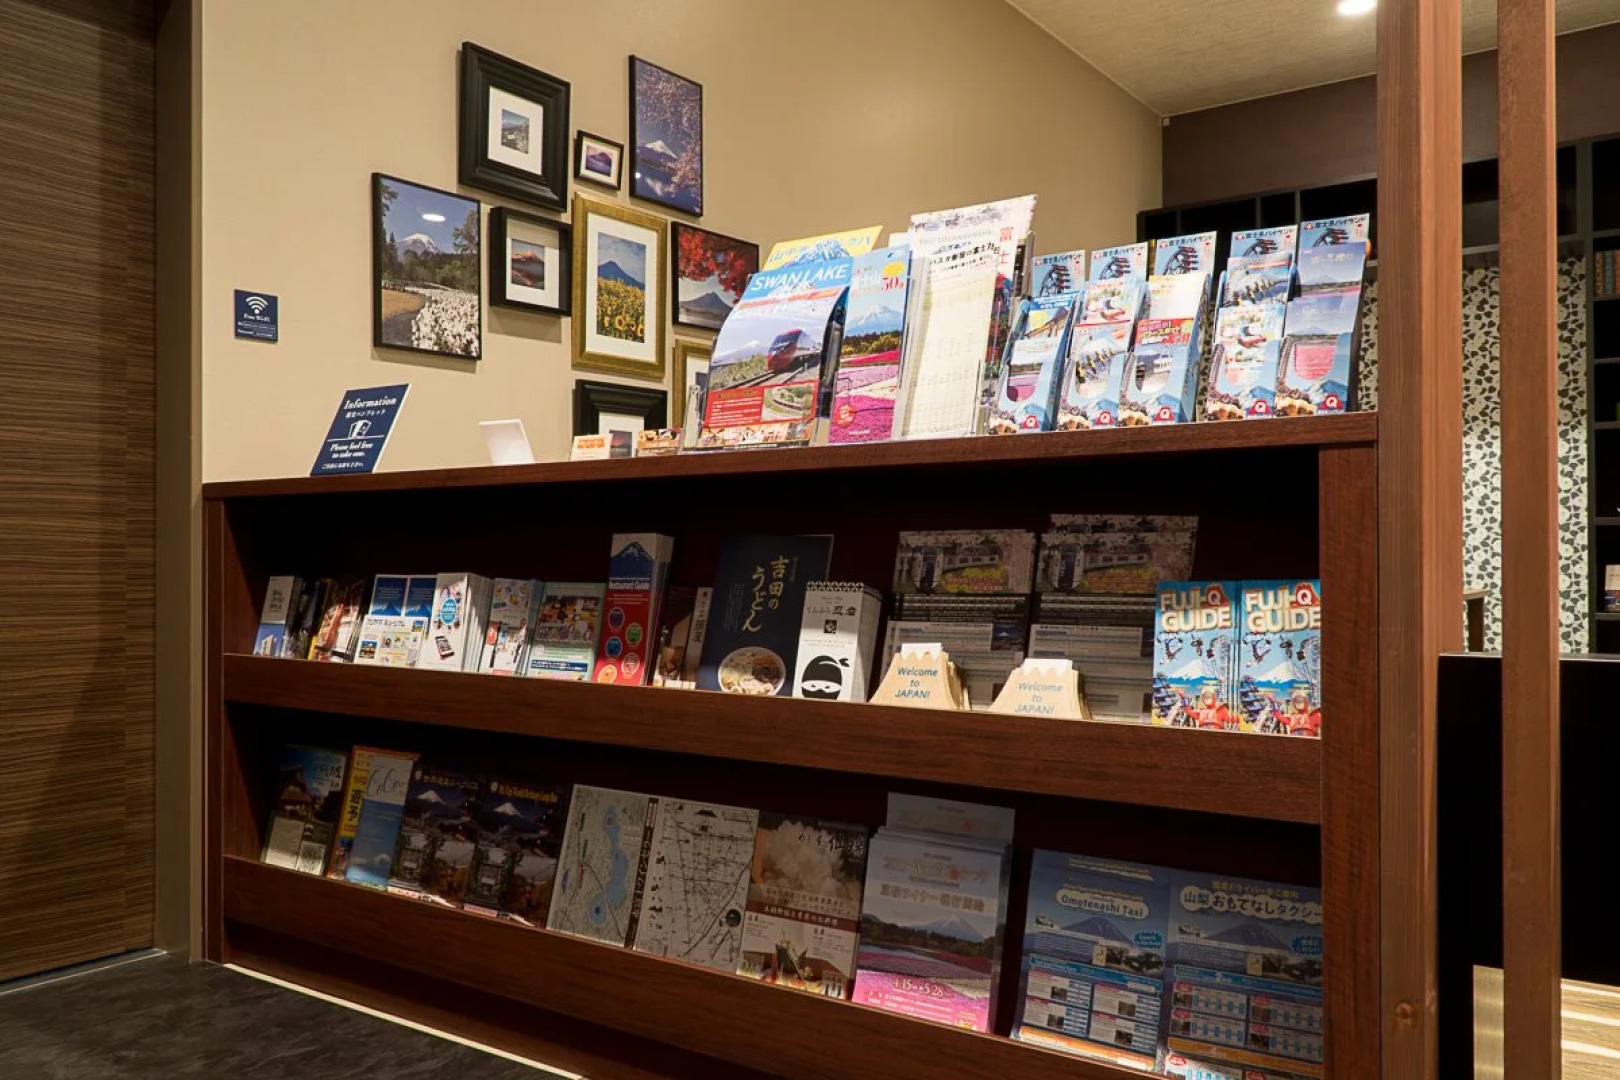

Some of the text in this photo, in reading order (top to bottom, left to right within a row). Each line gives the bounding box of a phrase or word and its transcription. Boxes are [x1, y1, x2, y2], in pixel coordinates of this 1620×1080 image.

[750, 271, 804, 291] SWAN
[800, 264, 849, 284] LAKE
[343, 396, 397, 410] Information
[768, 555, 789, 610] 吉田の
[742, 566, 766, 632] うどん
[1161, 605, 1231, 632] GUIDE
[1247, 606, 1321, 632] GUIDE
[897, 667, 938, 677] Welcome
[910, 679, 920, 687] to
[1018, 681, 1064, 692] Welcome
[895, 690, 930, 699] JAPAN!
[1032, 694, 1042, 703] to
[1015, 705, 1055, 714] JAPAN!
[1061, 894, 1143, 917] Omotenashi Taxi
